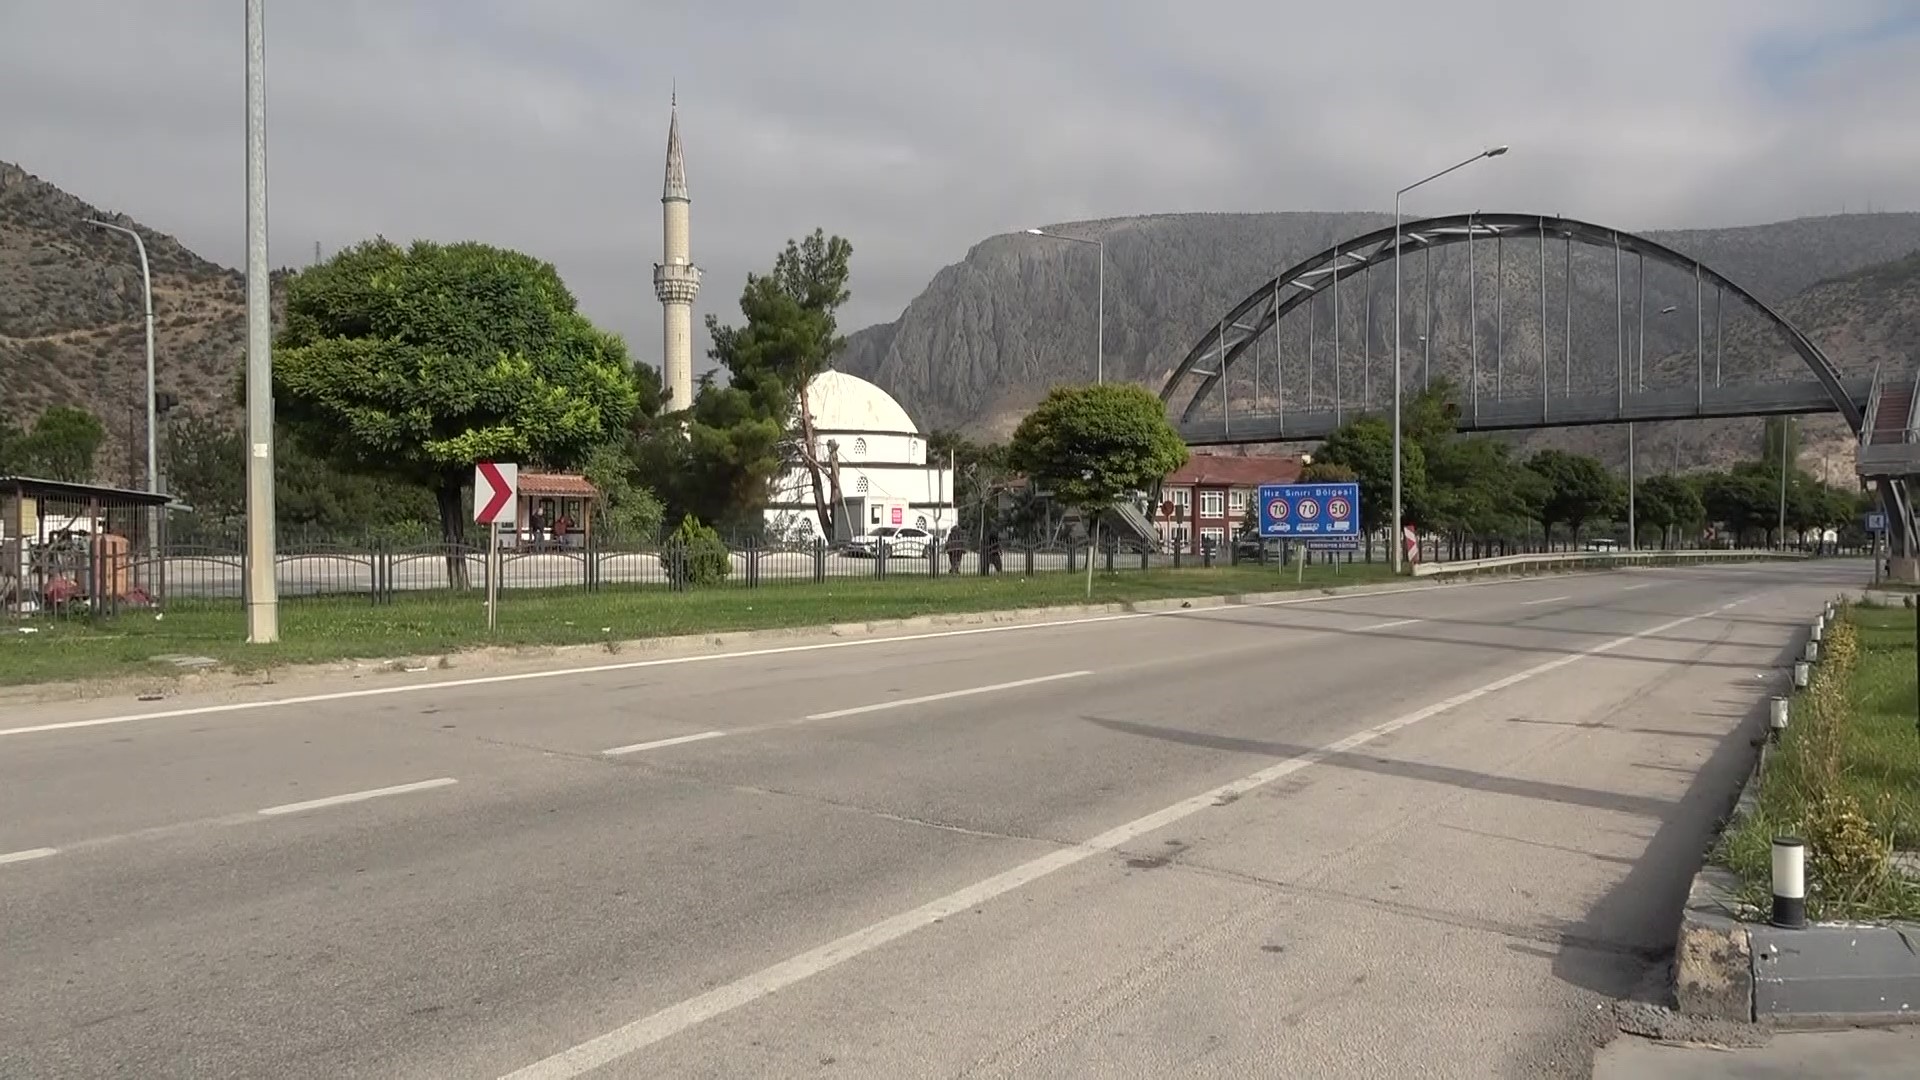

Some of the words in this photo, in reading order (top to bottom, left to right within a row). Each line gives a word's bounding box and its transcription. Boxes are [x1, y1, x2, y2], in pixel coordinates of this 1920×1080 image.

[1264, 489, 1280, 497] Hız
[1315, 487, 1353, 497] Bölgesi
[1272, 504, 1285, 515] 70
[1301, 504, 1315, 515] 70
[1331, 503, 1345, 514] 50
